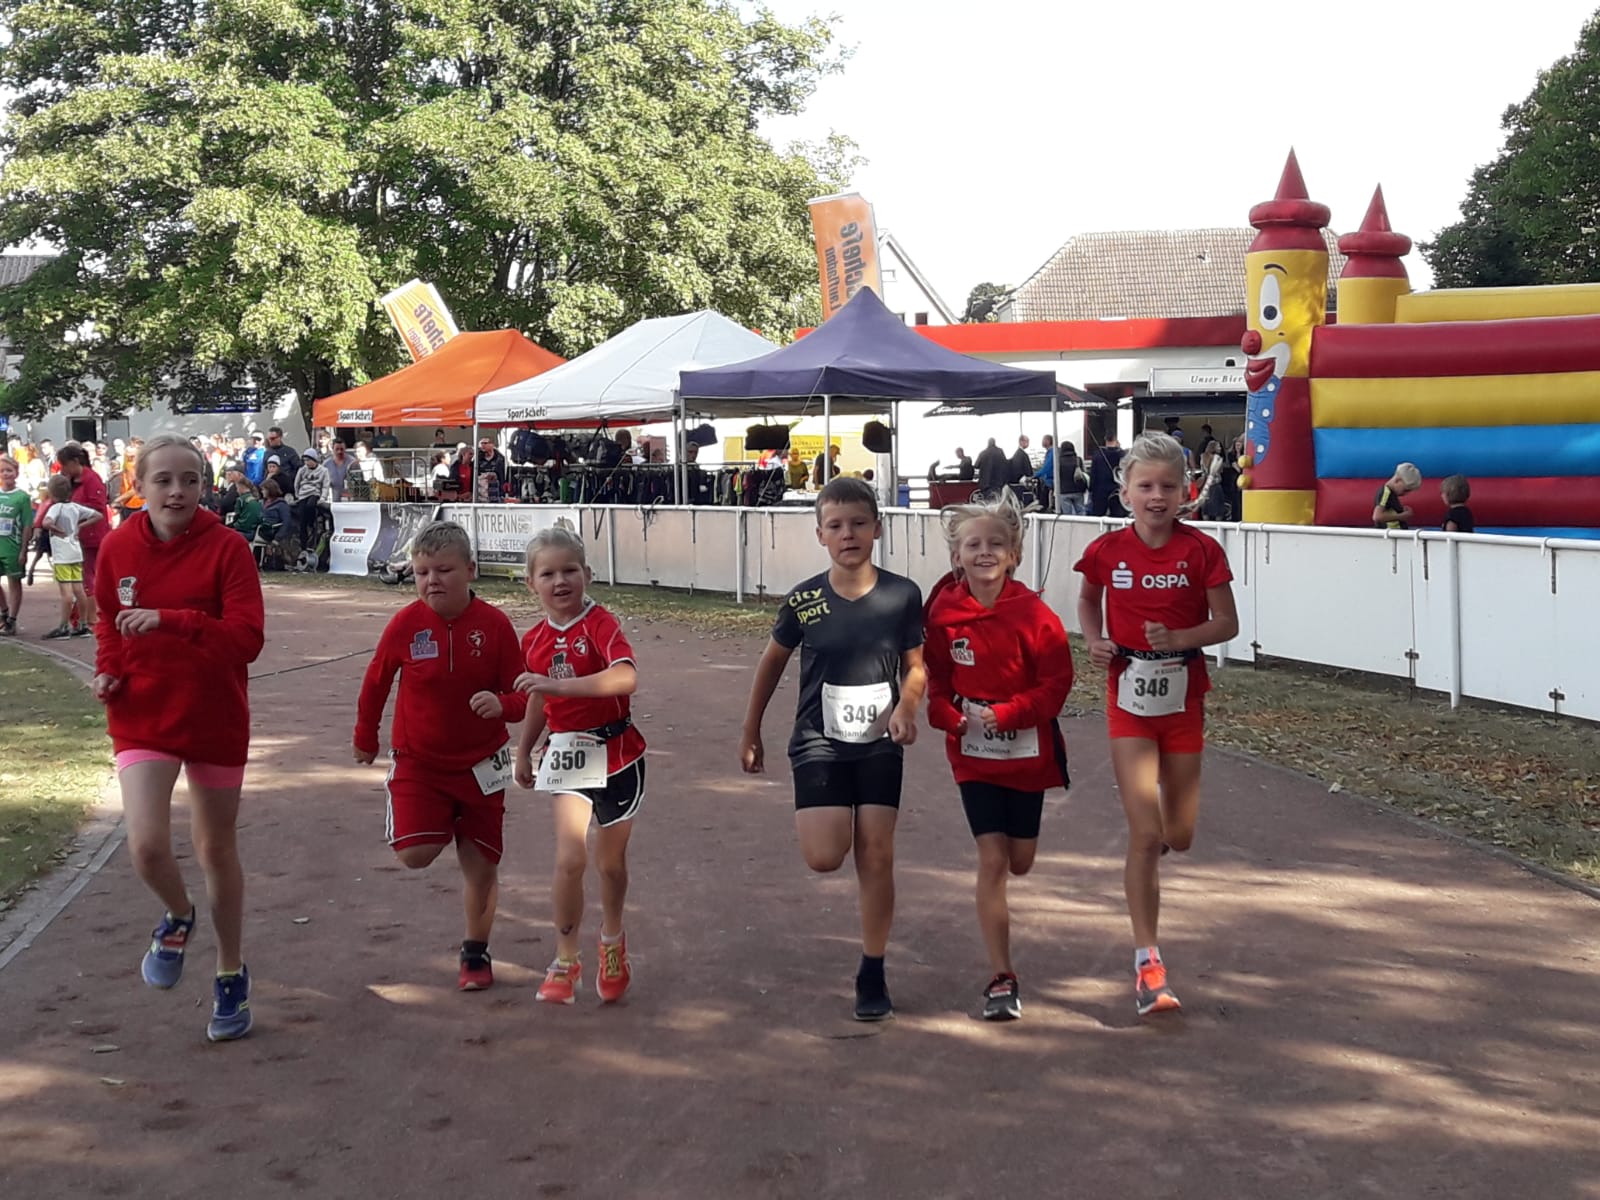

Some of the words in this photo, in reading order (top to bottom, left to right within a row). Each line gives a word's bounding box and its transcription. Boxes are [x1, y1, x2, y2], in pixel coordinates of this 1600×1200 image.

[1221, 374, 1244, 383] Bier
[1142, 574, 1190, 589] OSPA
[1134, 677, 1169, 697] 348
[843, 704, 877, 723] 349
[490, 747, 511, 771] 34
[550, 750, 586, 770] 350
